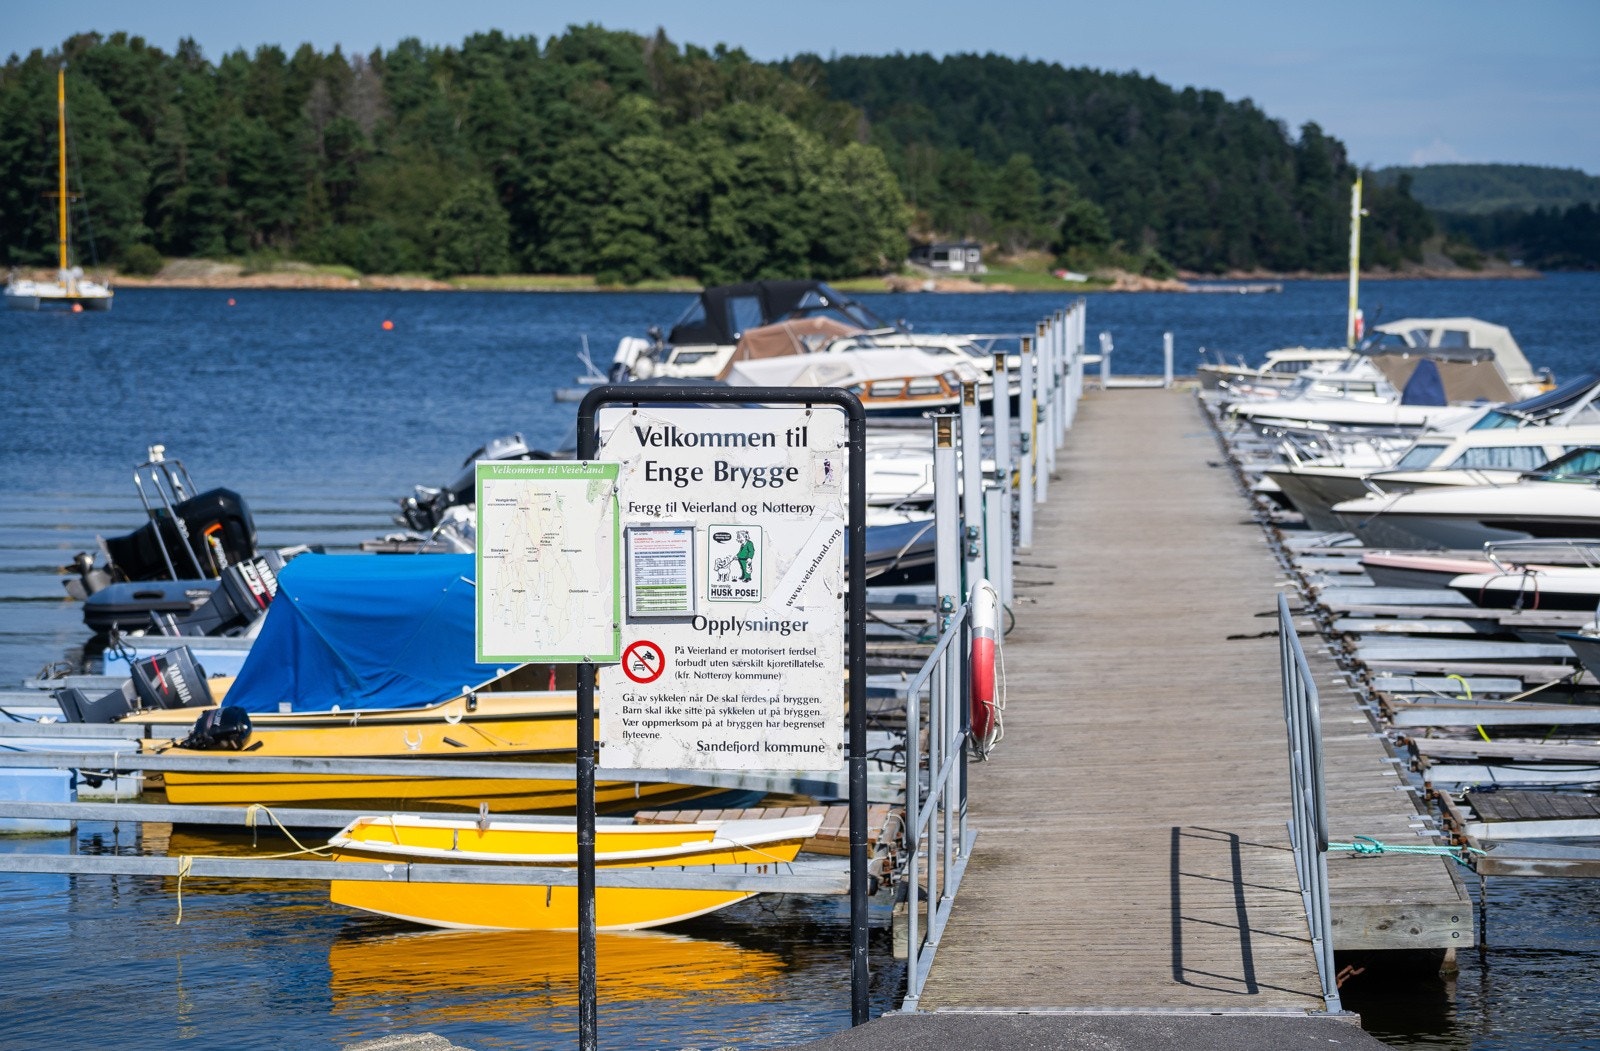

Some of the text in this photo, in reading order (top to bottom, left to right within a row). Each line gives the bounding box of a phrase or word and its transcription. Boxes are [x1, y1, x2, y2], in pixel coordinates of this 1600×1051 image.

[634, 425, 808, 448] Velkommen til
[491, 465, 605, 475] Velkommen til Veierland
[645, 460, 799, 489] Enge Brygge
[628, 501, 816, 516] Ferge til Veierland og Nøtterøy
[785, 528, 842, 607] www.veierland.org
[255, 558, 278, 597] YAMAH
[710, 588, 759, 597] HUSK POSE!
[691, 616, 809, 637] Opplysninger
[674, 645, 685, 655] På
[687, 646, 727, 655] Veierland
[741, 647, 786, 656] motorisert
[788, 647, 817, 656] ferdsel
[675, 658, 826, 670] forbudt uten særskilt kjøretillatelse.
[168, 663, 193, 704] YAMAHA
[693, 671, 732, 682] Nøtterøy
[734, 671, 782, 681] kommune)
[622, 693, 635, 702] Gå
[649, 693, 688, 704] sykkelen
[690, 693, 703, 702] når
[706, 693, 720, 703] De
[721, 694, 738, 703] skal
[741, 694, 767, 703] ferdes
[769, 695, 780, 706] på
[783, 695, 823, 708] bryggen.
[622, 705, 824, 720] Barn skal ikke sitte på sykkelen ut på bryggen.
[622, 717, 826, 732] Vær oppmerksom på at bryggen har begrenset
[622, 730, 661, 740] flyteevne.
[696, 740, 826, 754] Sandefjord kommune
